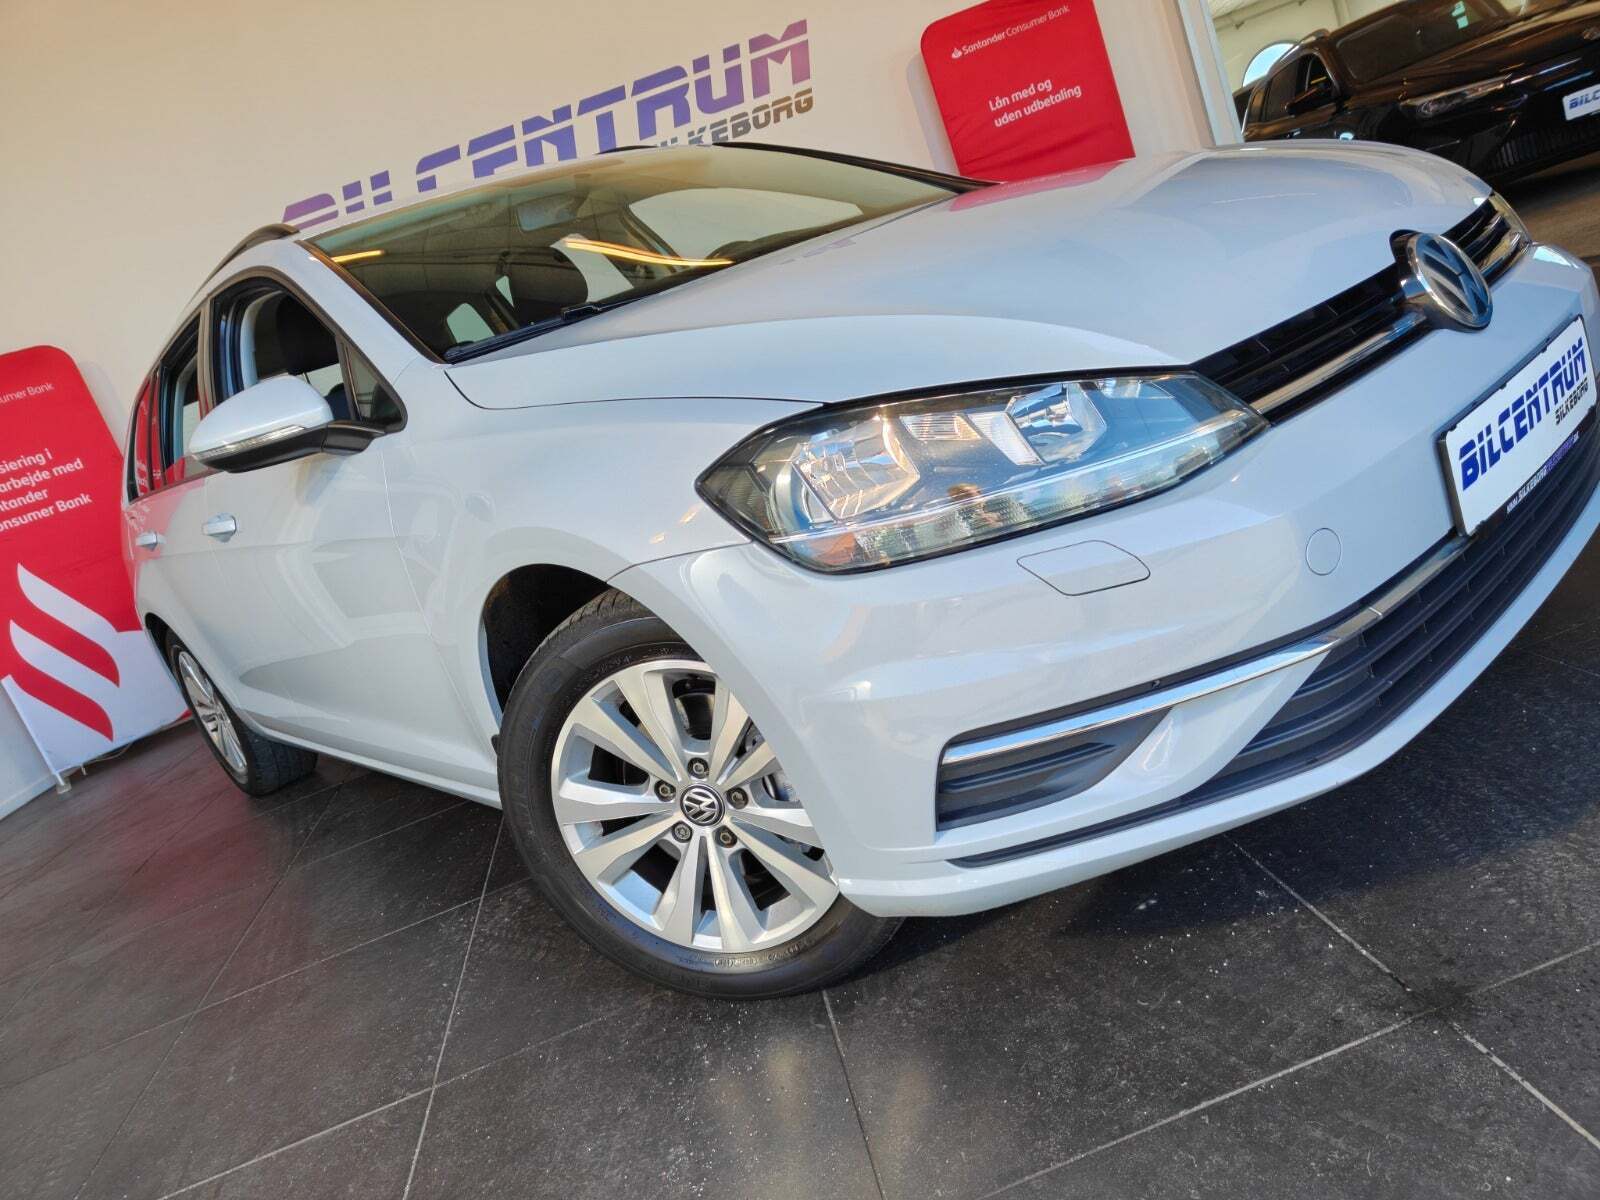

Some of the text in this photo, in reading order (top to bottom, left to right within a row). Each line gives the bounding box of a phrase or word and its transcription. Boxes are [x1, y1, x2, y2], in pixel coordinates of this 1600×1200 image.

[962, 5, 1070, 55] Santander Consumer Bank
[989, 79, 1052, 111] Lån med og
[994, 85, 1082, 127] uden udbetaling
[660, 88, 814, 148] KEBORG
[26, 382, 55, 396] Bank
[1555, 376, 1588, 425] SILKEBORG
[1458, 336, 1587, 492] BILCENTRUM
[45, 448, 52, 460] i
[53, 457, 84, 477] med
[56, 493, 93, 513] Bank
